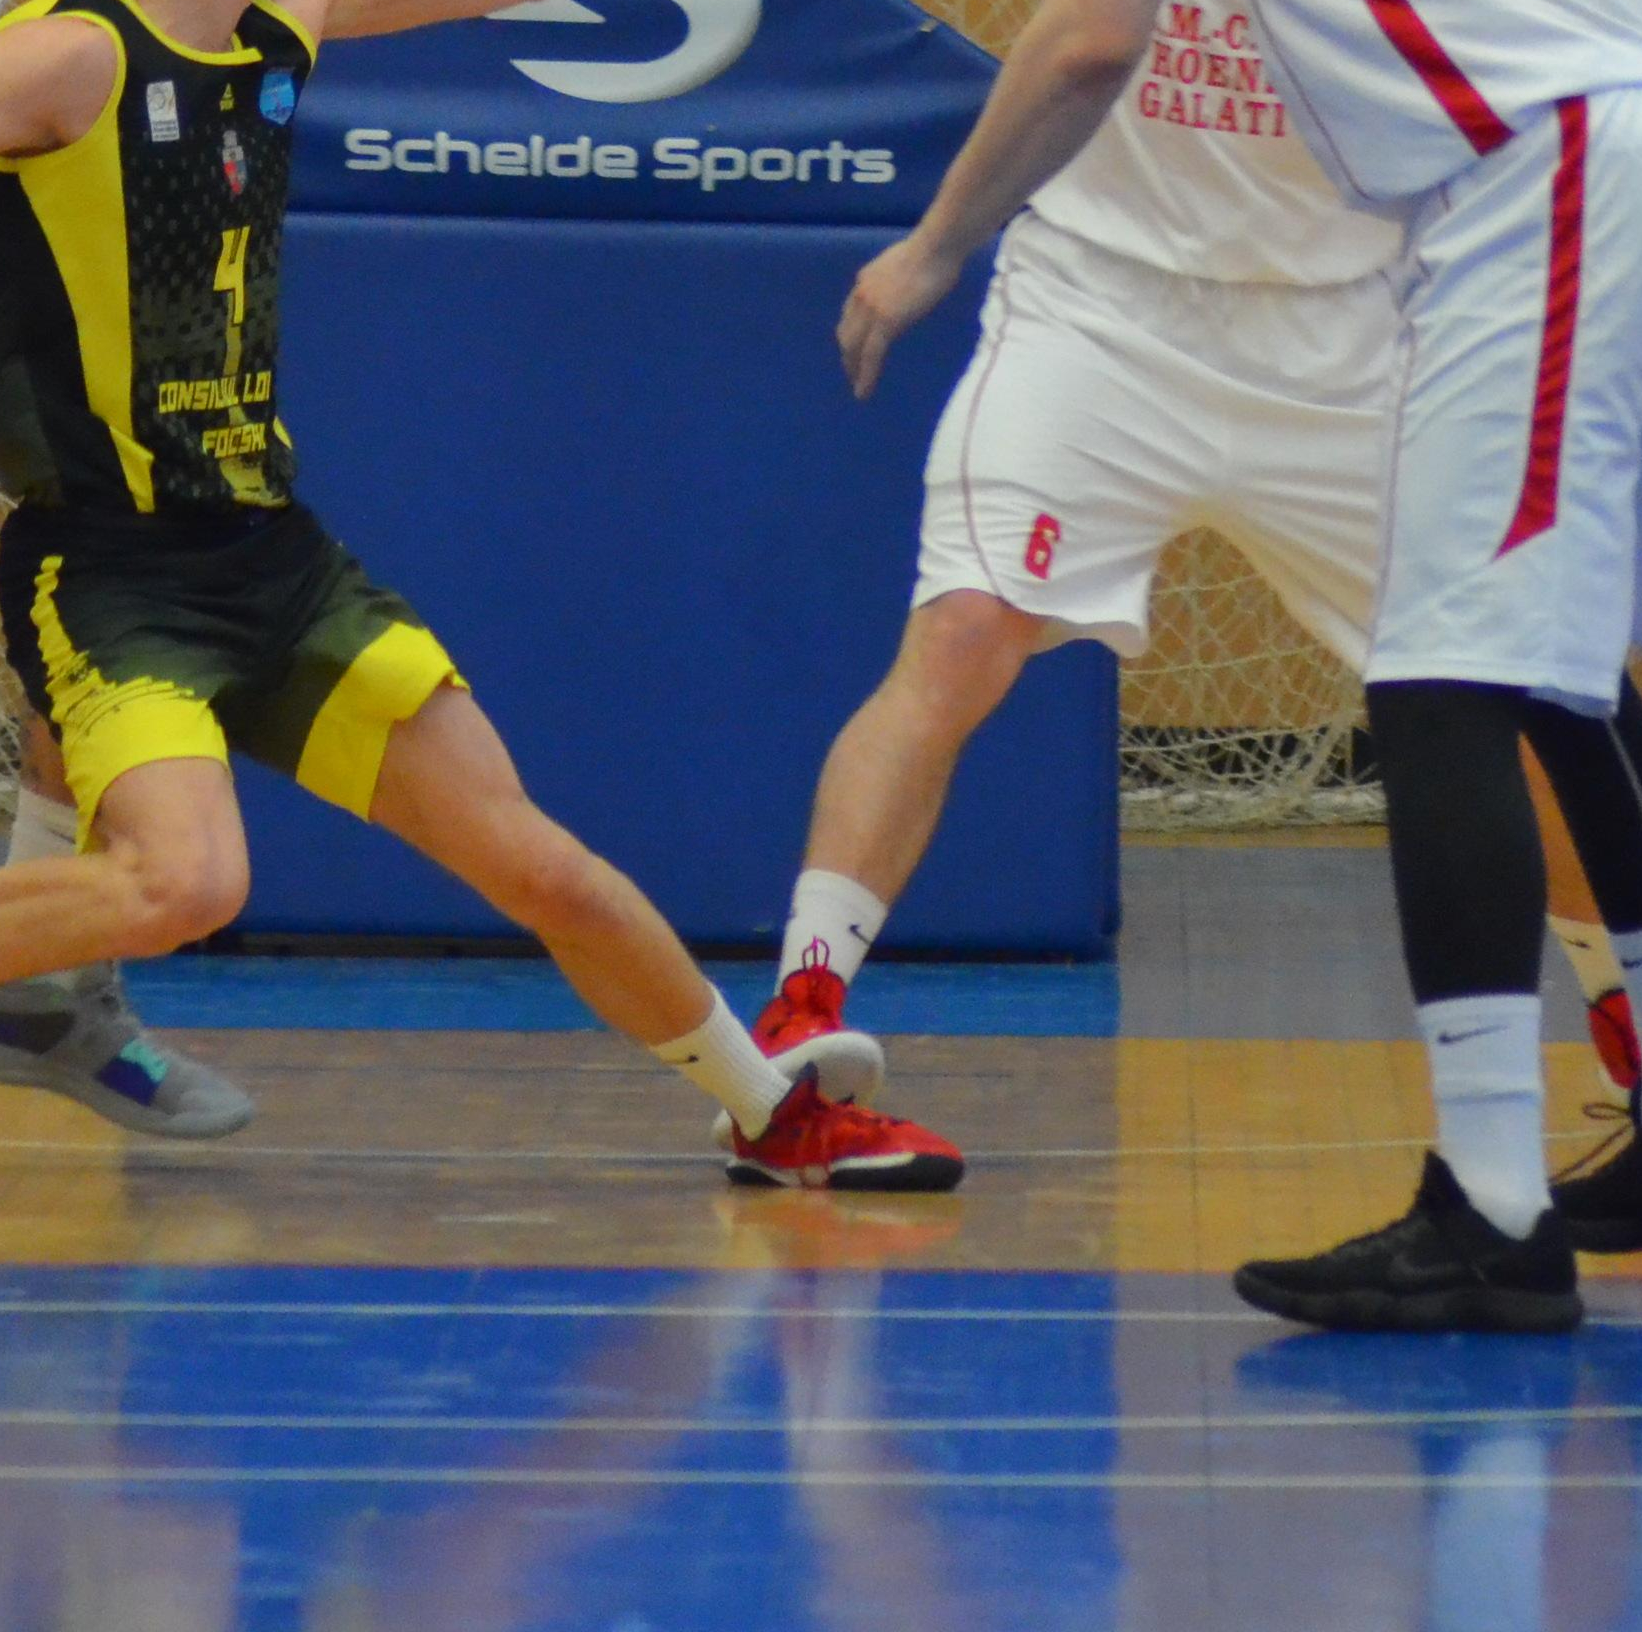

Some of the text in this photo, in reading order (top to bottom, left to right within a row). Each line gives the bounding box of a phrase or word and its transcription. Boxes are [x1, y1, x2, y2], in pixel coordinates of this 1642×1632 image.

[344, 128, 895, 192] Schelde Sports
[212, 225, 251, 325] 4
[1024, 511, 1062, 581] 6
